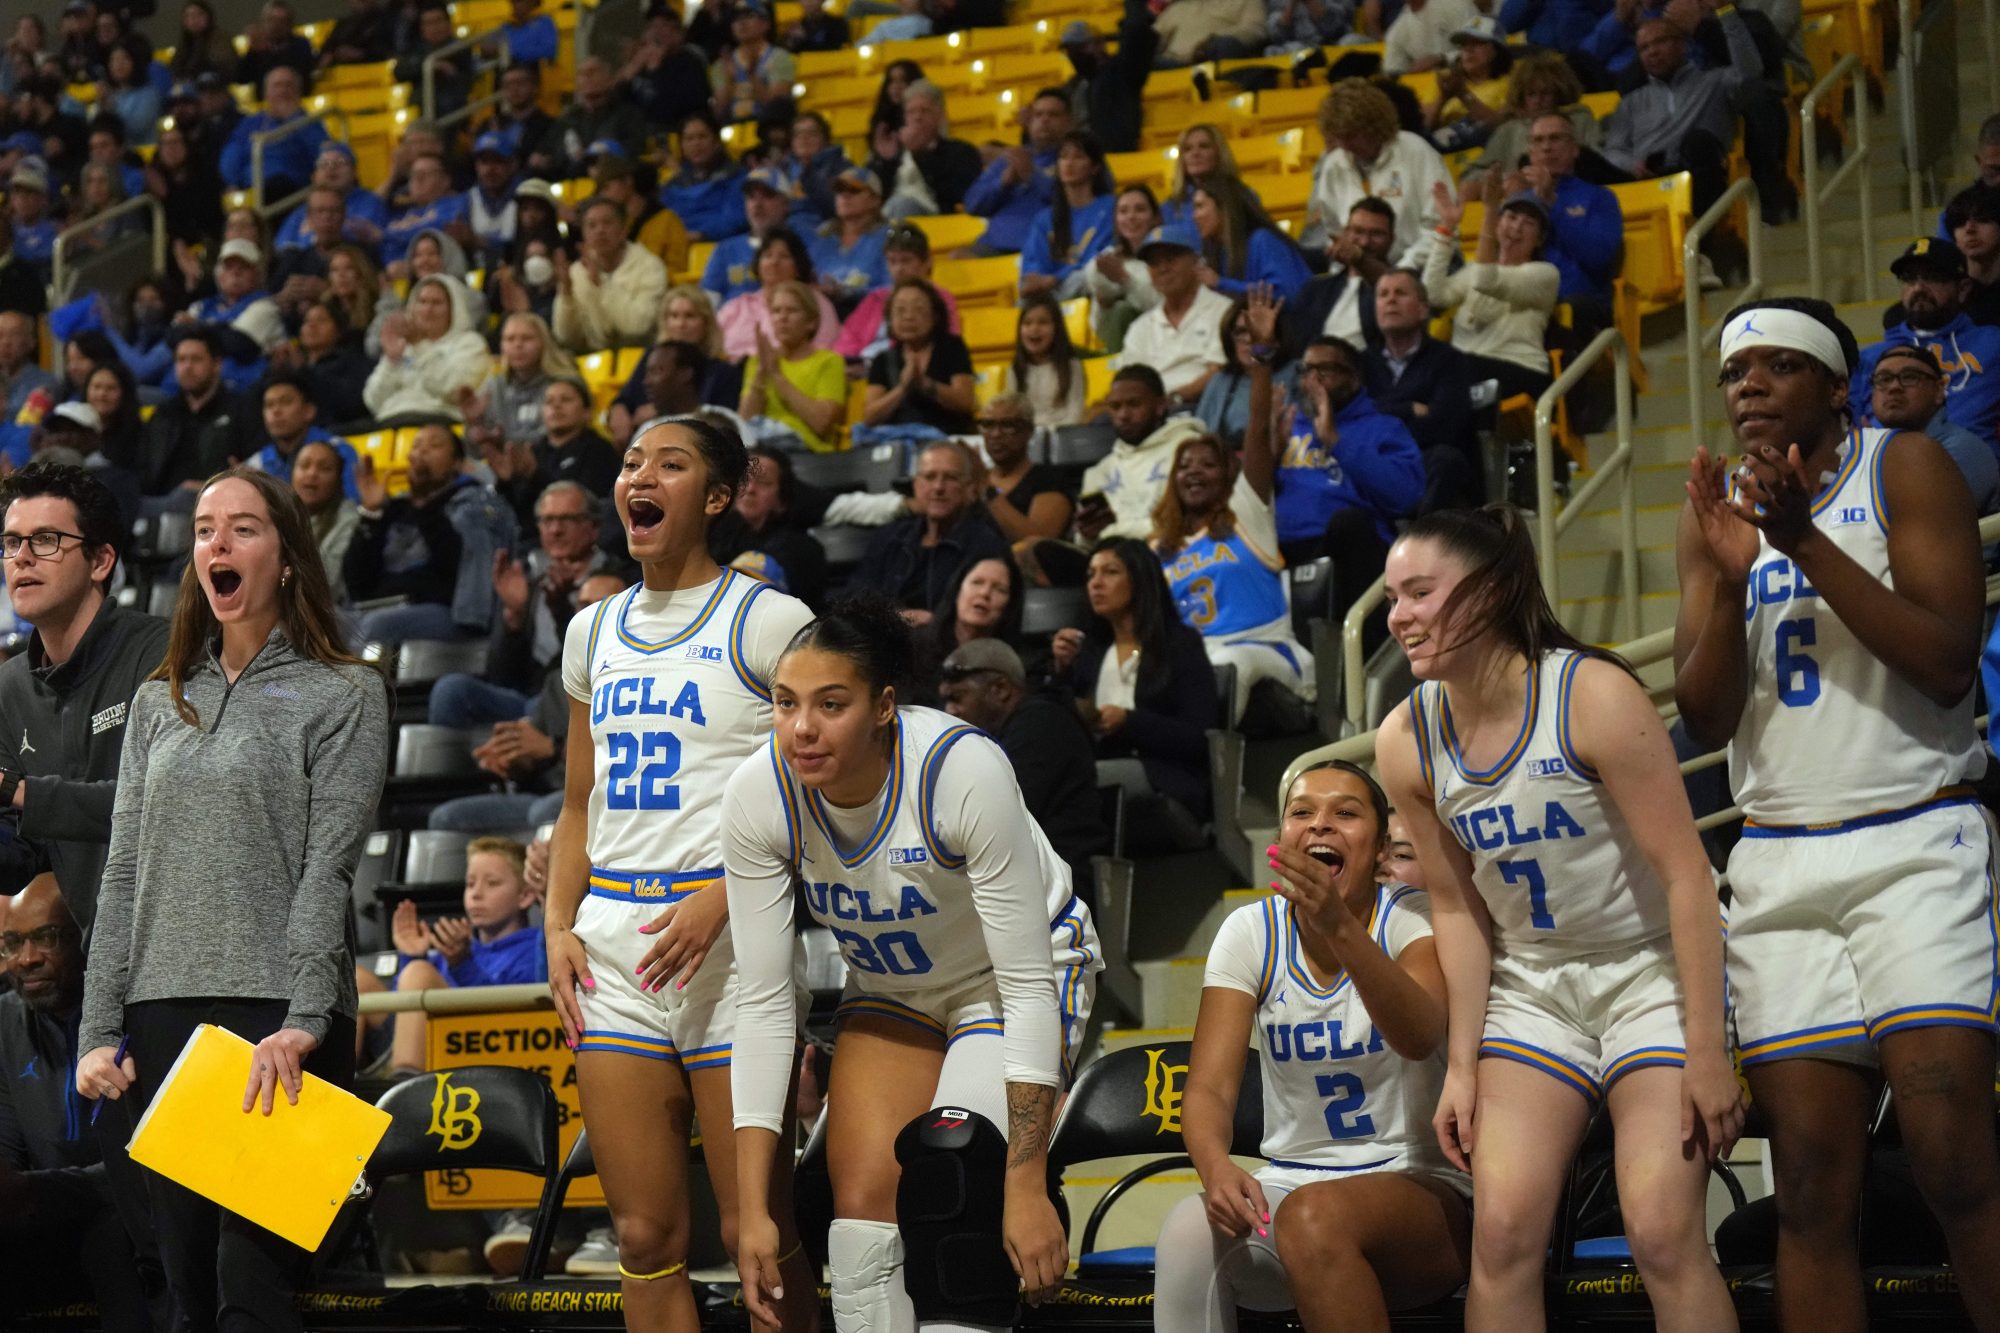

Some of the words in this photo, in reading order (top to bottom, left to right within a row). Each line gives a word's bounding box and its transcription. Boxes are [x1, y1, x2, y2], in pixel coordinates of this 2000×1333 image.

[1775, 617, 1821, 708] 6
[592, 677, 706, 727] UCLA
[607, 732, 681, 810] 22
[1449, 801, 1586, 852] UCLA
[634, 878, 667, 898] Ucla
[803, 880, 938, 922] UCLA
[1496, 859, 1556, 929] 7
[829, 924, 934, 975] 30
[425, 1072, 482, 1152] LB
[1314, 1072, 1376, 1139] 2
[531, 1291, 581, 1312] BEACH
[583, 1291, 624, 1312] STAT
